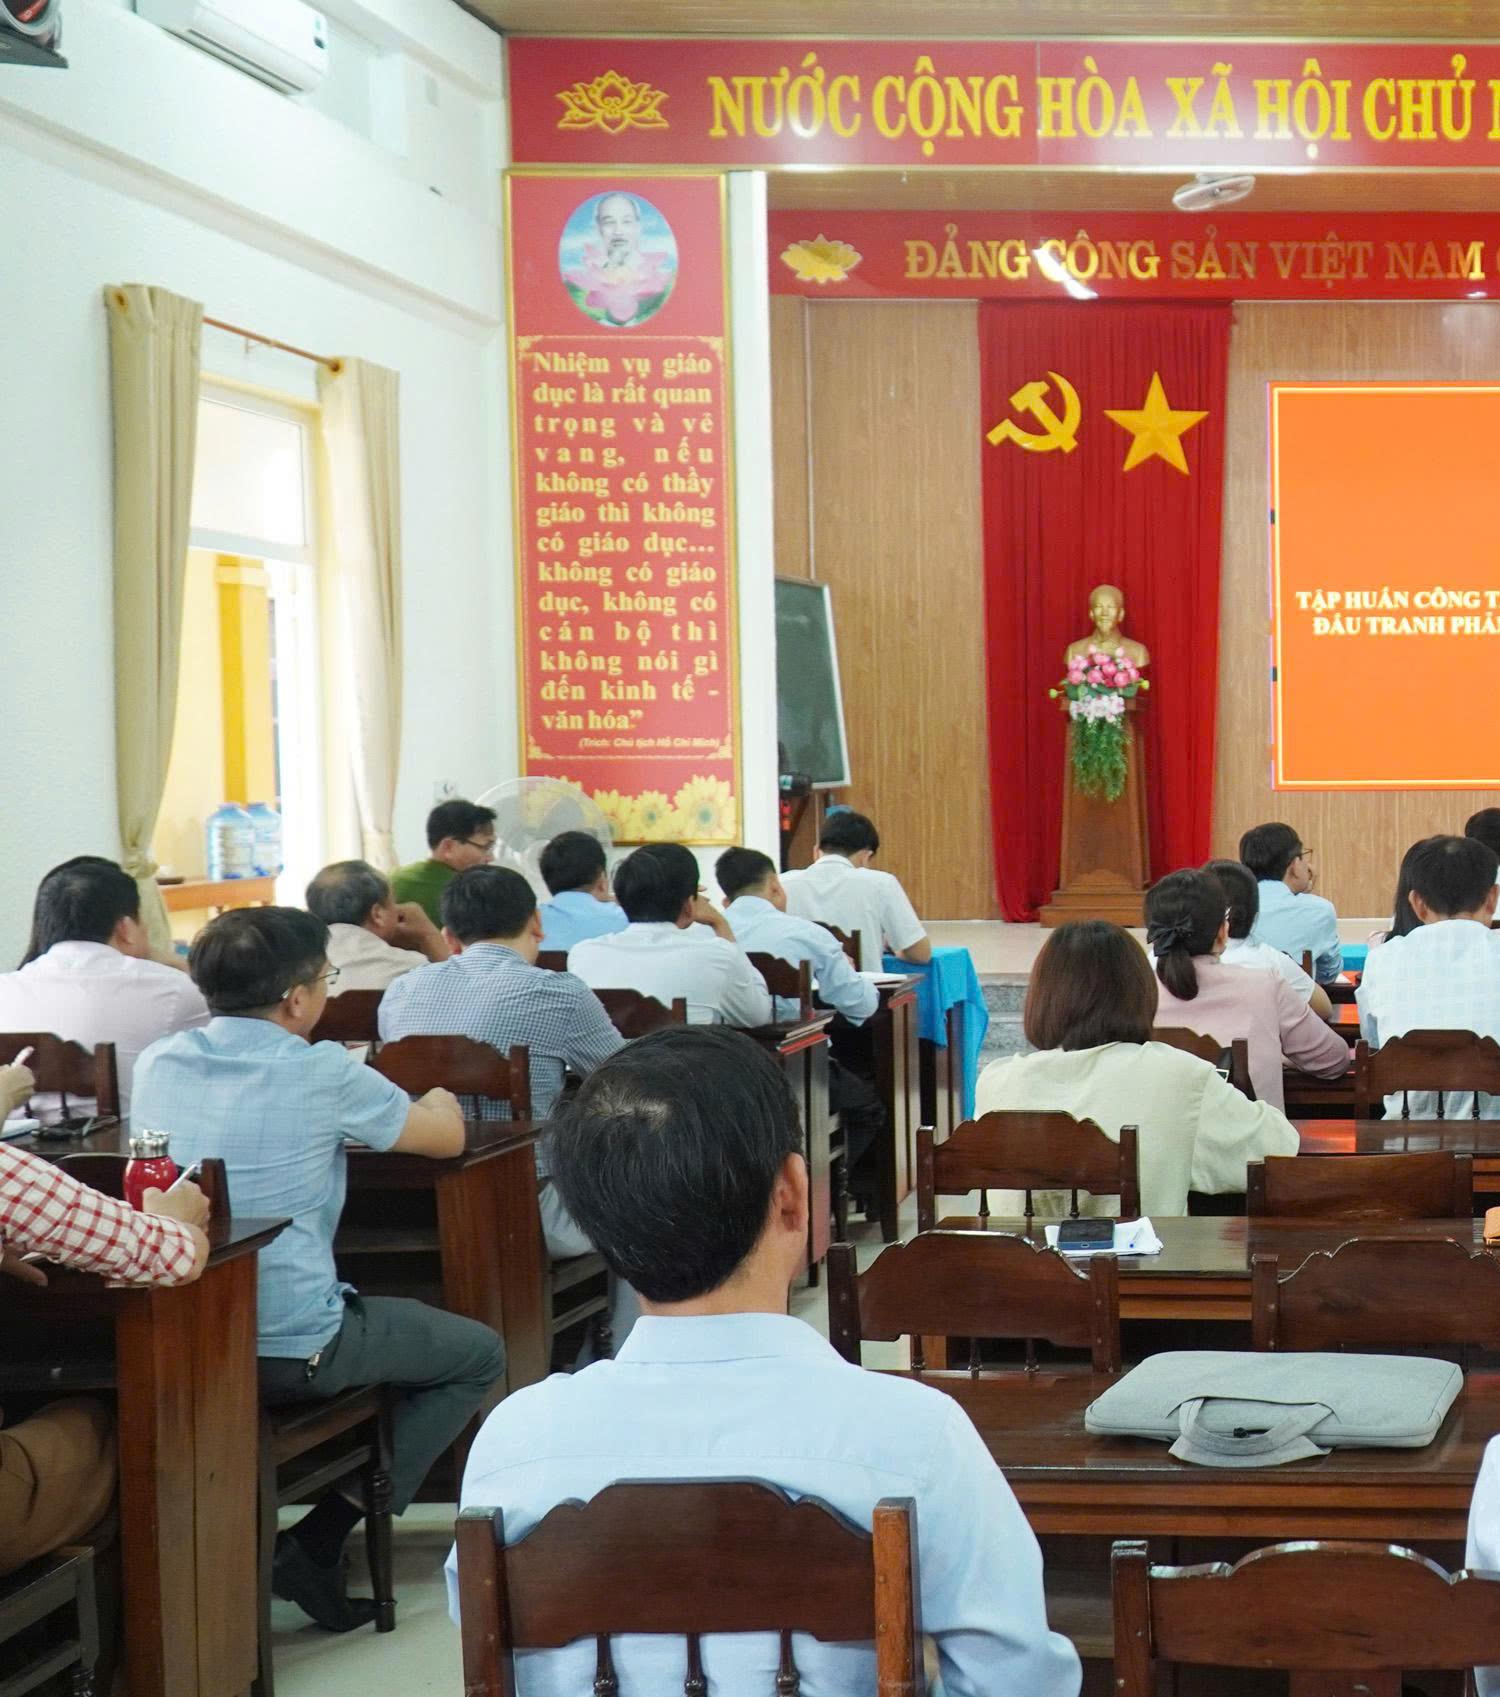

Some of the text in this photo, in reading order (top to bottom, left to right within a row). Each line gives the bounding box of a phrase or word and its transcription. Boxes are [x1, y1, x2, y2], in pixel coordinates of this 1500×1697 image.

[709, 53, 861, 138] NƯỚC
[872, 56, 1024, 155] CỘNG
[1038, 56, 1152, 139] HÒA
[1166, 63, 1245, 140] XÃ
[1254, 57, 1351, 158] HỘI
[1363, 53, 1475, 141] CHỦ
[904, 223, 1030, 280] ĐẢNG
[1172, 224, 1257, 280] SẢN
[1269, 232, 1373, 288] VIỆT
[1385, 241, 1485, 280] NAM
[623, 358, 650, 378] vụ
[663, 352, 712, 379] giáo
[534, 382, 575, 408] dục
[584, 382, 604, 403] là
[653, 388, 712, 409] quan
[534, 412, 615, 439] trọng
[633, 412, 665, 433] và
[535, 436, 714, 469] vang, nếu
[537, 466, 713, 498] không có thầy
[537, 501, 715, 528] giáo thì không
[537, 530, 715, 558] có giáo dục...
[539, 560, 717, 588] không có giáo
[539, 590, 717, 618] dục, không có
[1296, 588, 1341, 613] TẬP
[1414, 586, 1481, 609] CÔNG
[539, 620, 718, 646] cán bộ thì
[1365, 616, 1445, 635] TRANH
[541, 649, 718, 676] không nói gì
[541, 674, 585, 700] đến
[601, 679, 657, 700] kinh
[671, 674, 695, 700] tế
[542, 708, 583, 730] văn
